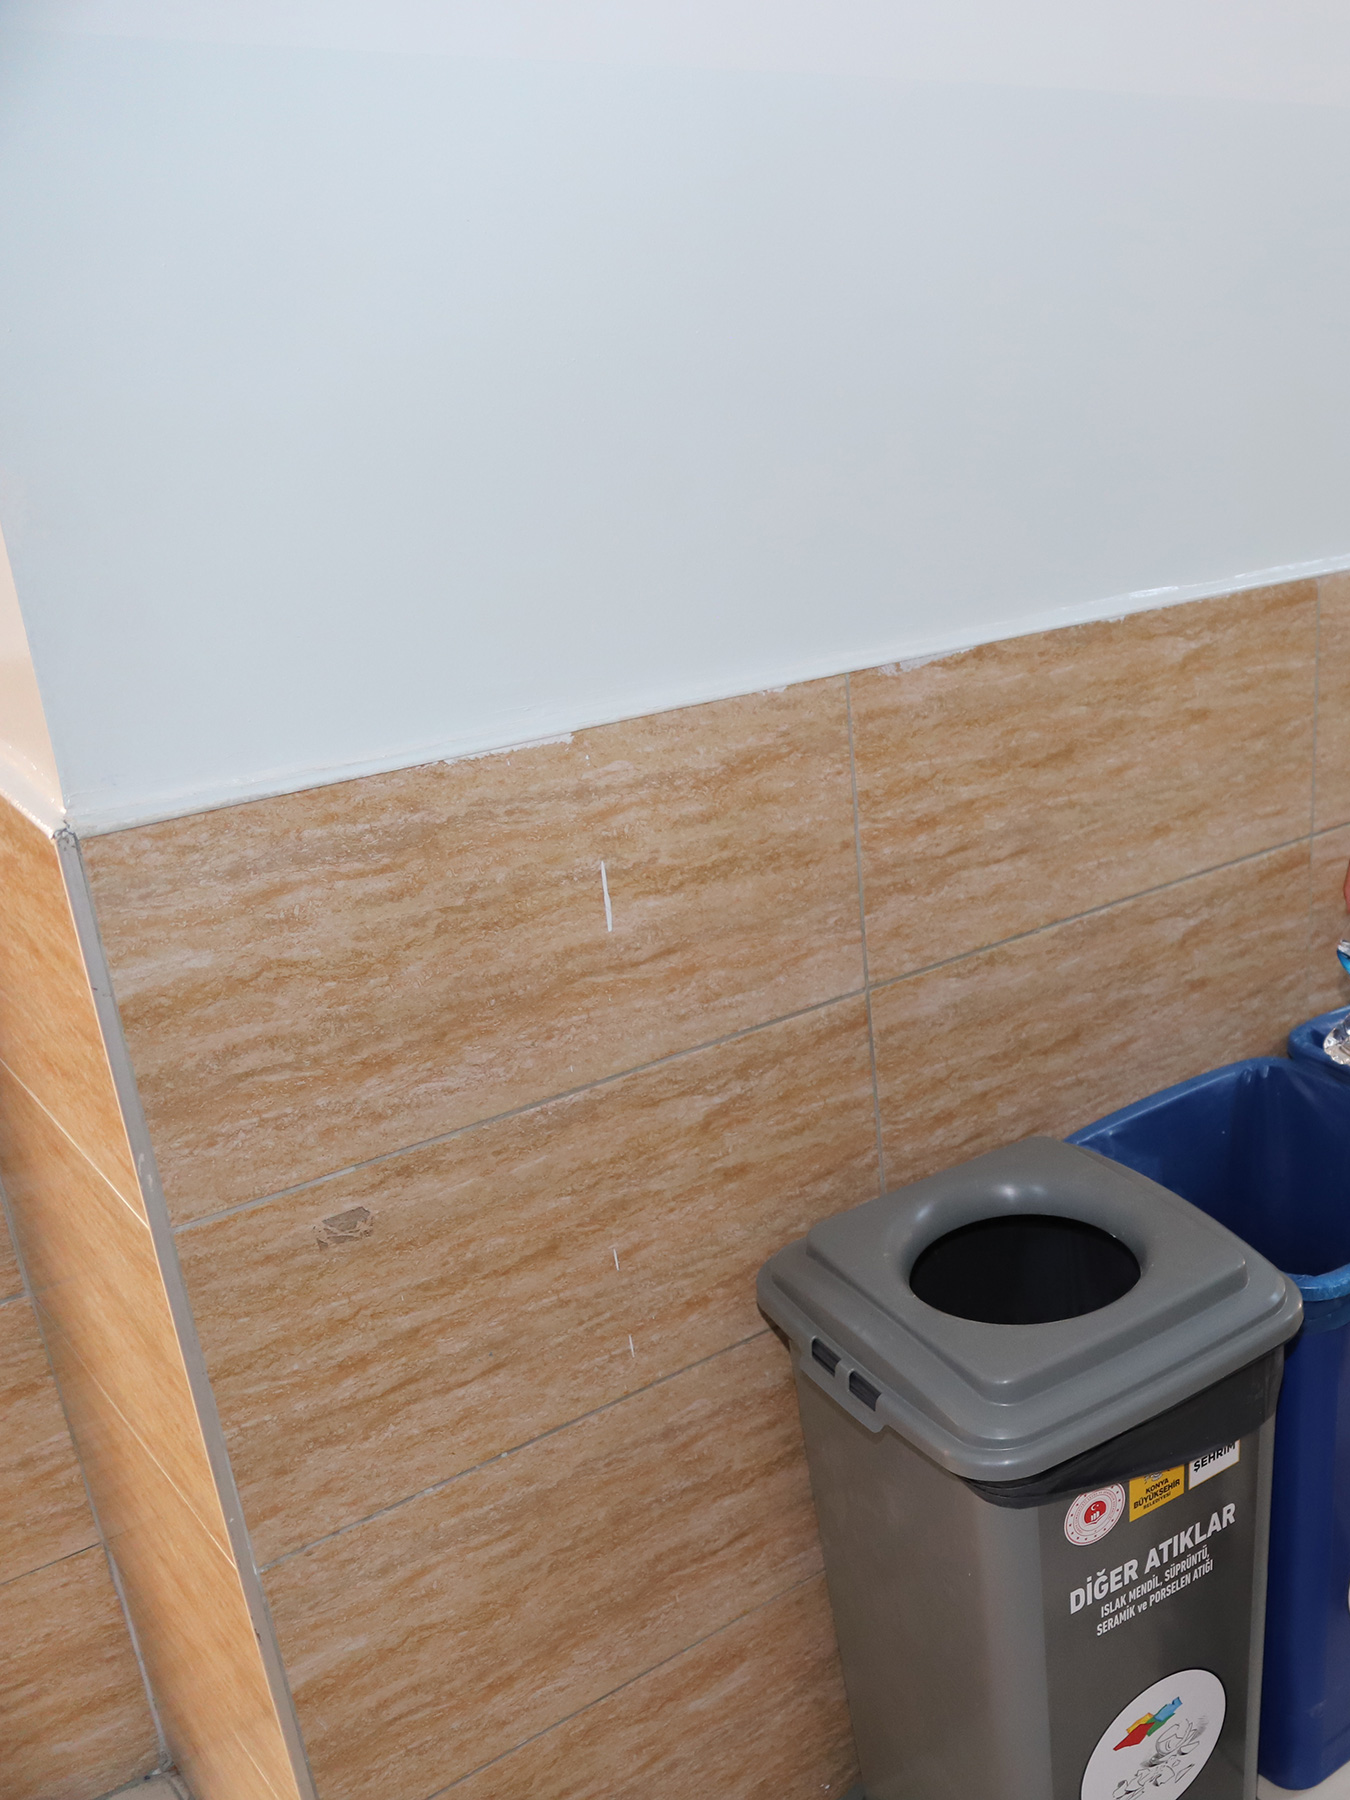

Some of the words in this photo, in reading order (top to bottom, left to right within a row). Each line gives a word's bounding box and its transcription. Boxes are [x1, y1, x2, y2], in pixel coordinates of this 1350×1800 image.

[1133, 1479, 1181, 1509] BÜYÜKŞEHİR
[1146, 1478, 1169, 1494] KONYA
[1070, 1559, 1138, 1614] DİĞER
[1144, 1503, 1237, 1574] ATIKLAR
[1101, 1594, 1127, 1618] ISLAK
[1128, 1573, 1163, 1600] MENDİL,
[1164, 1546, 1210, 1582] SÜPRÜNTÜ,
[1097, 1604, 1136, 1636] SERAMİK
[1137, 1600, 1148, 1613] ve
[1149, 1576, 1191, 1606] PORSELEN
[1193, 1558, 1214, 1581] ATIĞI
